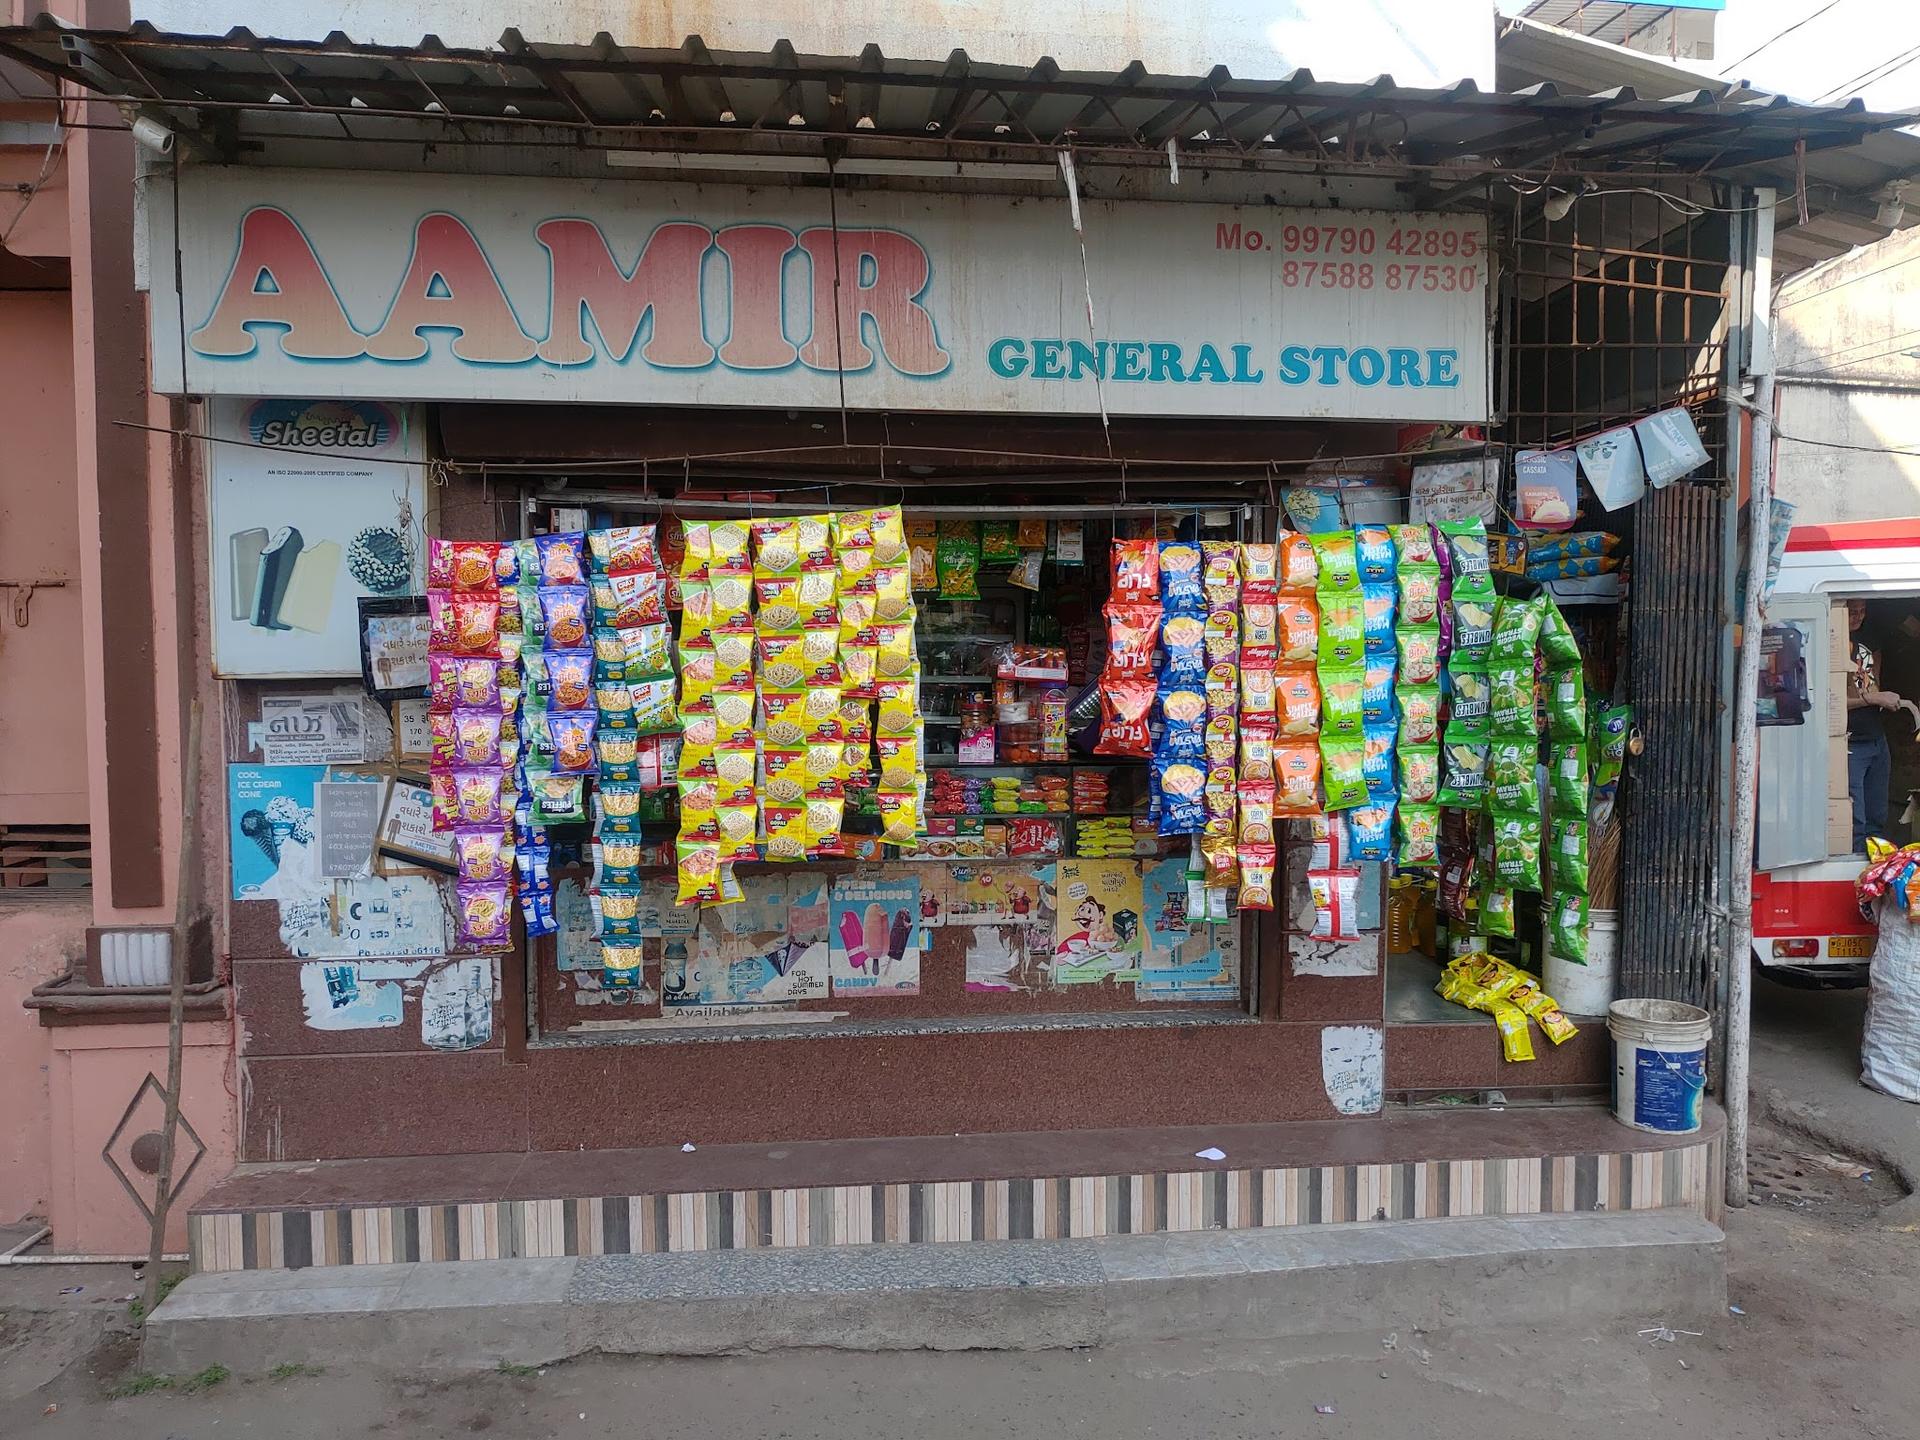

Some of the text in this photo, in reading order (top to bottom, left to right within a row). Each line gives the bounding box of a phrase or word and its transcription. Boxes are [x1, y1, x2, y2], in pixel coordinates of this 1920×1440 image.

[1216, 222, 1478, 258] Mo. 99790 42895
[1282, 260, 1476, 293] 87588 87530
[187, 203, 952, 378] AAMIR
[987, 336, 1462, 389] GENERAL STORE
[260, 420, 378, 448] Sheetal
[1523, 465, 1547, 475] CASSATA
[1402, 528, 1422, 539] Bites
[1289, 556, 1315, 567] SIMPLY
[1460, 558, 1489, 572] UMBLES
[1117, 572, 1152, 589] FLIP
[1408, 586, 1429, 597] Bites
[554, 606, 577, 619] Bites
[813, 610, 832, 619] GOPAL
[463, 612, 486, 625] Bites
[730, 616, 748, 625] GOPAL
[1288, 630, 1315, 641] SIMPLY
[1460, 629, 1491, 647] UMBLES
[1497, 628, 1522, 639] STRAW
[1497, 634, 1523, 647] VEGGIE
[1247, 648, 1270, 658] Kellogg's
[1408, 648, 1429, 659] Bites
[1112, 653, 1147, 669] FLIP
[816, 667, 835, 676] GOPAL
[559, 671, 581, 685] Bites
[731, 675, 749, 683] GOPAL
[633, 684, 651, 696] CRAX
[767, 704, 785, 713] GOPAL
[1286, 702, 1313, 713] SIMPLY
[1409, 706, 1430, 718] Bites
[1494, 707, 1518, 719] STRAW
[403, 714, 415, 723] 35
[1496, 713, 1520, 725] VEGGIE
[410, 727, 423, 735] 170
[818, 724, 837, 733] GOPAL
[1111, 723, 1143, 740] FLIP
[562, 734, 585, 746] Bites
[732, 732, 750, 740] GOPAL
[468, 746, 490, 757] Bites
[880, 747, 899, 756] GOPAL
[769, 761, 787, 770] GOPAL
[1409, 765, 1430, 777] Bites
[237, 771, 262, 779] COOL
[1284, 774, 1312, 786] SIMPLY
[237, 780, 282, 789] ICE CREAM
[818, 781, 837, 790] GOPAL
[1289, 782, 1315, 792] SALTED
[1496, 784, 1521, 794] STRAW
[238, 790, 262, 799] CONE
[733, 790, 751, 798] GOPAL
[1498, 790, 1523, 801] VEGGIE
[541, 800, 574, 810] PUFFLES
[882, 802, 900, 811] GOPAL
[400, 806, 421, 819] વધારે
[468, 806, 490, 817] Bites
[401, 821, 427, 836] શકાશે
[769, 818, 787, 828] GOPAL
[699, 825, 717, 834] GOPAL
[1411, 826, 1431, 837] Bites
[471, 864, 493, 875] Bites
[1498, 859, 1524, 869] STRAW
[1251, 872, 1263, 880] CORN
[1500, 866, 1525, 875] VEGGIE
[698, 889, 716, 897] GOPAL
[845, 889, 913, 901] DELICIOUS
[472, 921, 494, 932] Bites
[792, 981, 824, 989] SUMMER
[834, 977, 878, 988] CANDY
[787, 988, 807, 996] DAYS
